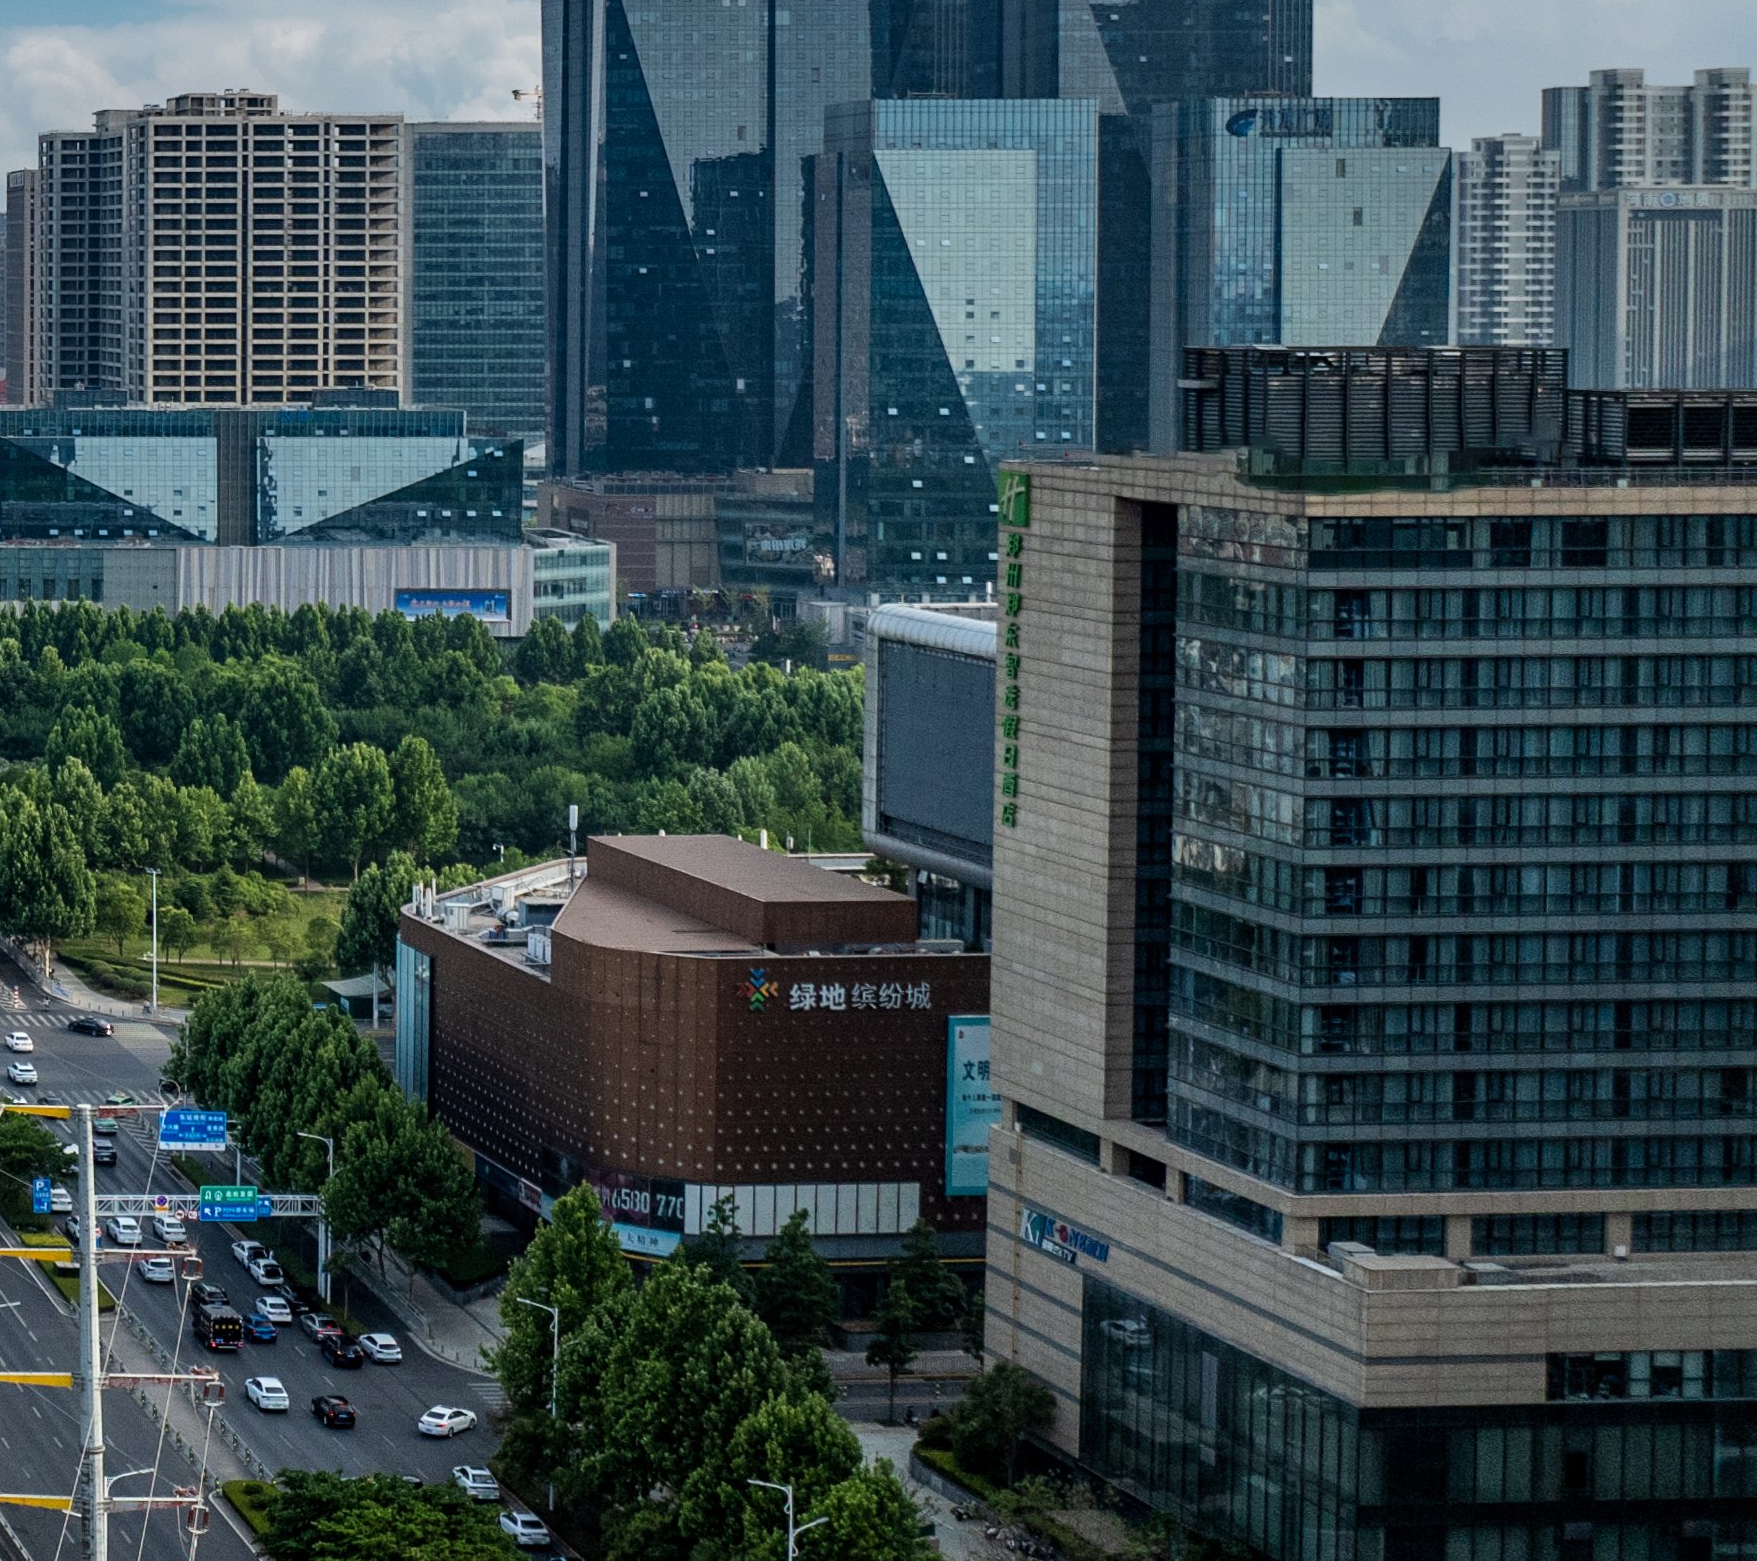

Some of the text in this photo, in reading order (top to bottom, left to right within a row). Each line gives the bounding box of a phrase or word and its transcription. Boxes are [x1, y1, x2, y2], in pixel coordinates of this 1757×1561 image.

[789, 981, 932, 1011] 绿地缤纷城
